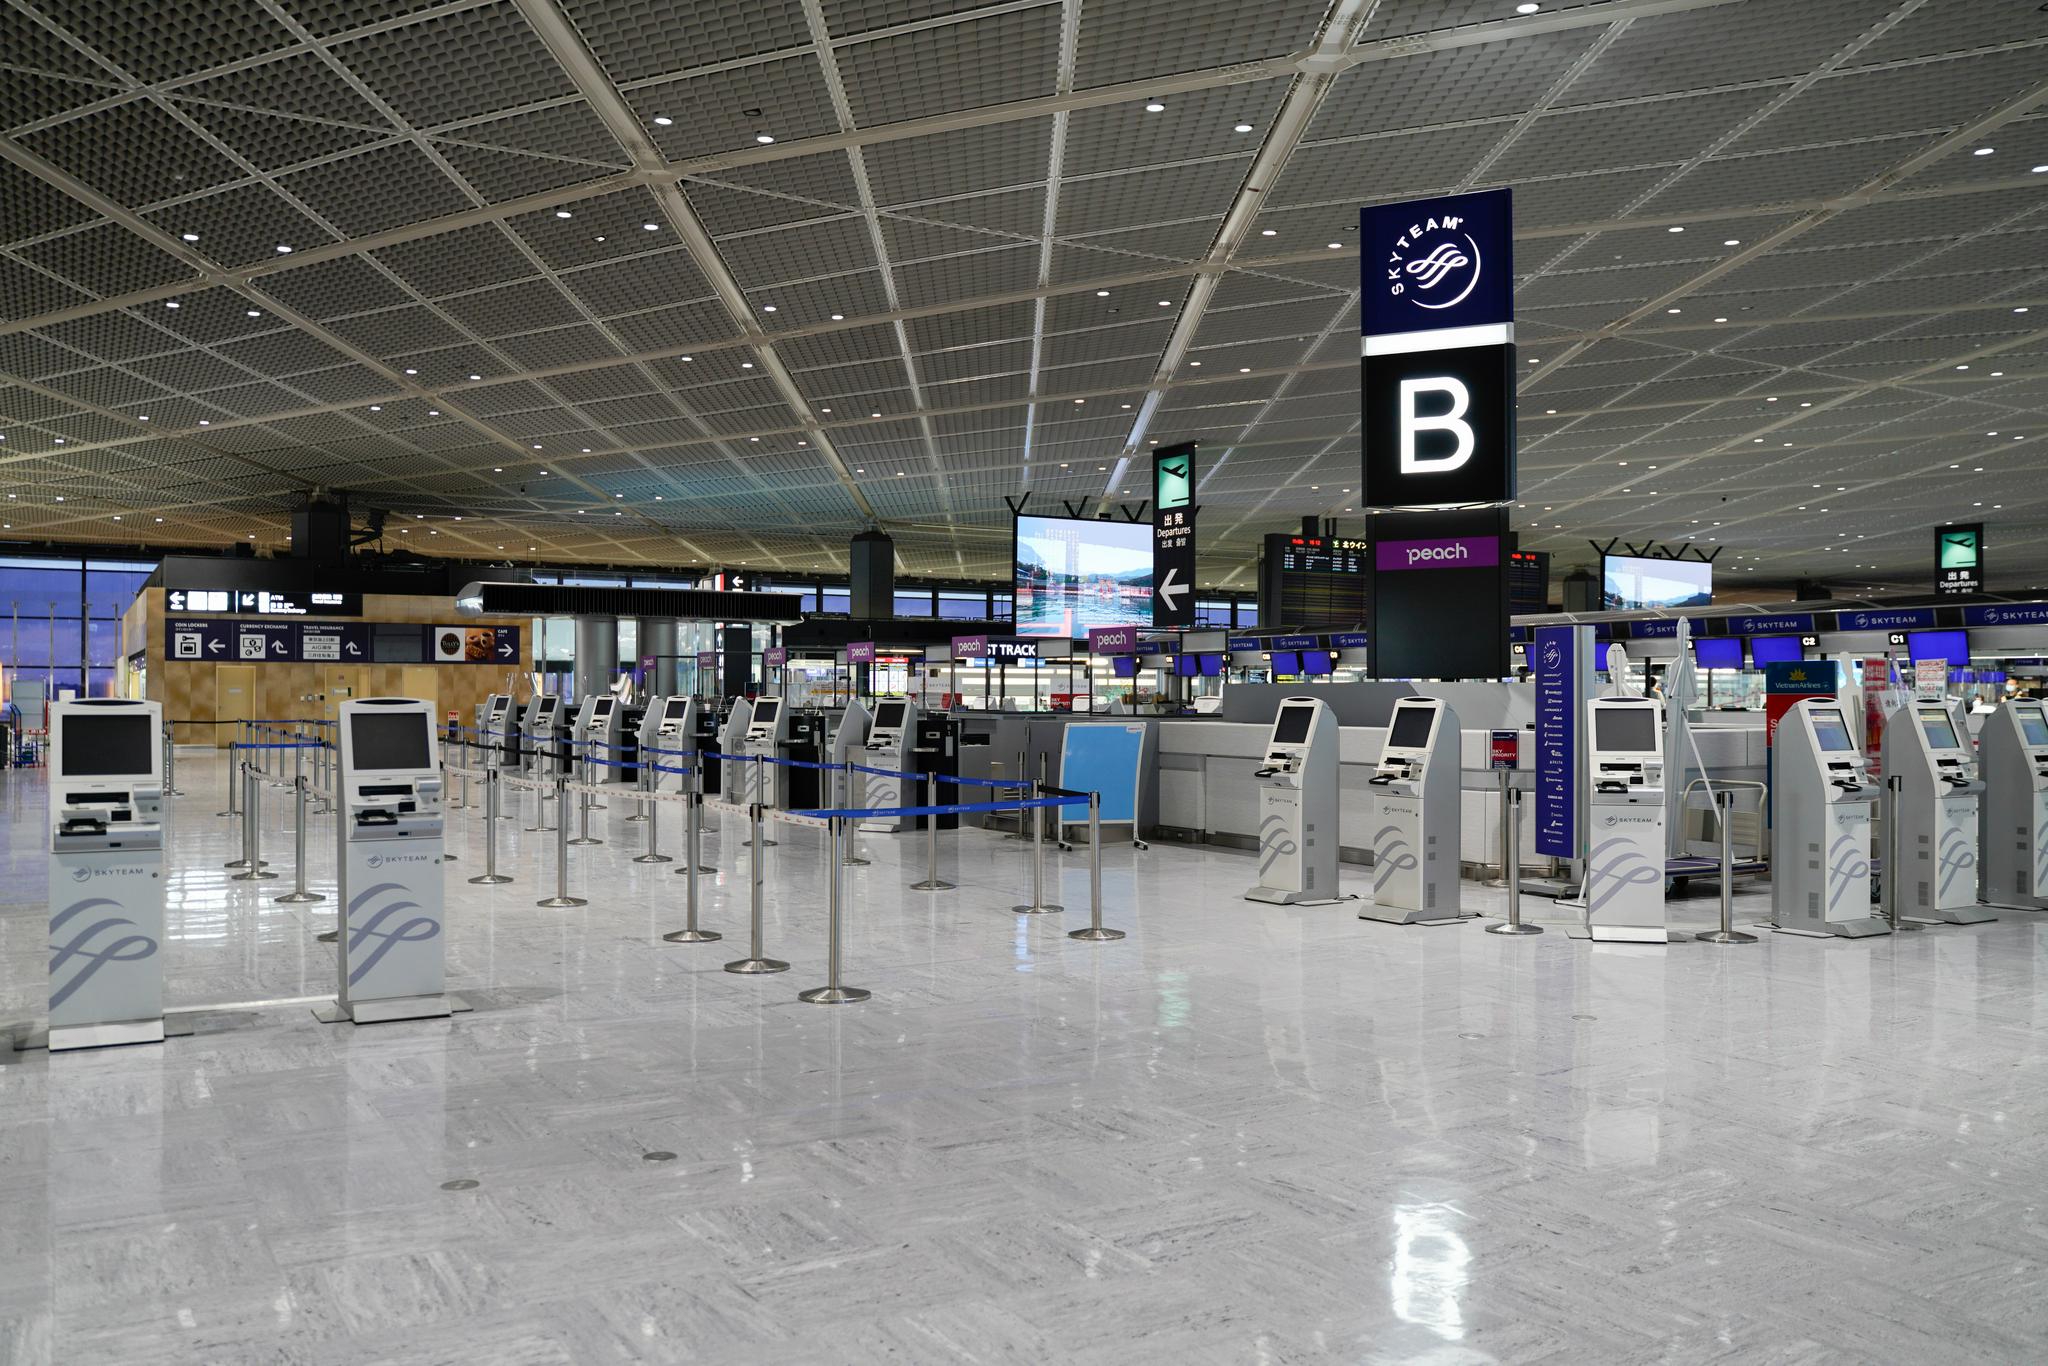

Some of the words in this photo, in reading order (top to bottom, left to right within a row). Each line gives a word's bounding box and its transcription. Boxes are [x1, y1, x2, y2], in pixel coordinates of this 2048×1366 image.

[1388, 216, 1459, 296] SKYTEAM
[1400, 376, 1475, 474] B
[1164, 512, 1184, 527] 出発
[1157, 526, 1191, 539] Departures
[1406, 543, 1468, 565] peach
[1940, 580, 1978, 589] Departures
[1757, 621, 1798, 629] SKYTEAM
[1871, 616, 1917, 625] SKYTEAM
[1096, 631, 1127, 649] peach
[1802, 637, 1816, 646] C2
[1890, 634, 1904, 644] C1
[851, 645, 870, 657] peach
[957, 639, 981, 655] peach
[999, 644, 1037, 656] TRACK
[767, 651, 783, 662] peach
[385, 855, 428, 863] SKYTEAM
[94, 868, 144, 876] SKYTEAM
